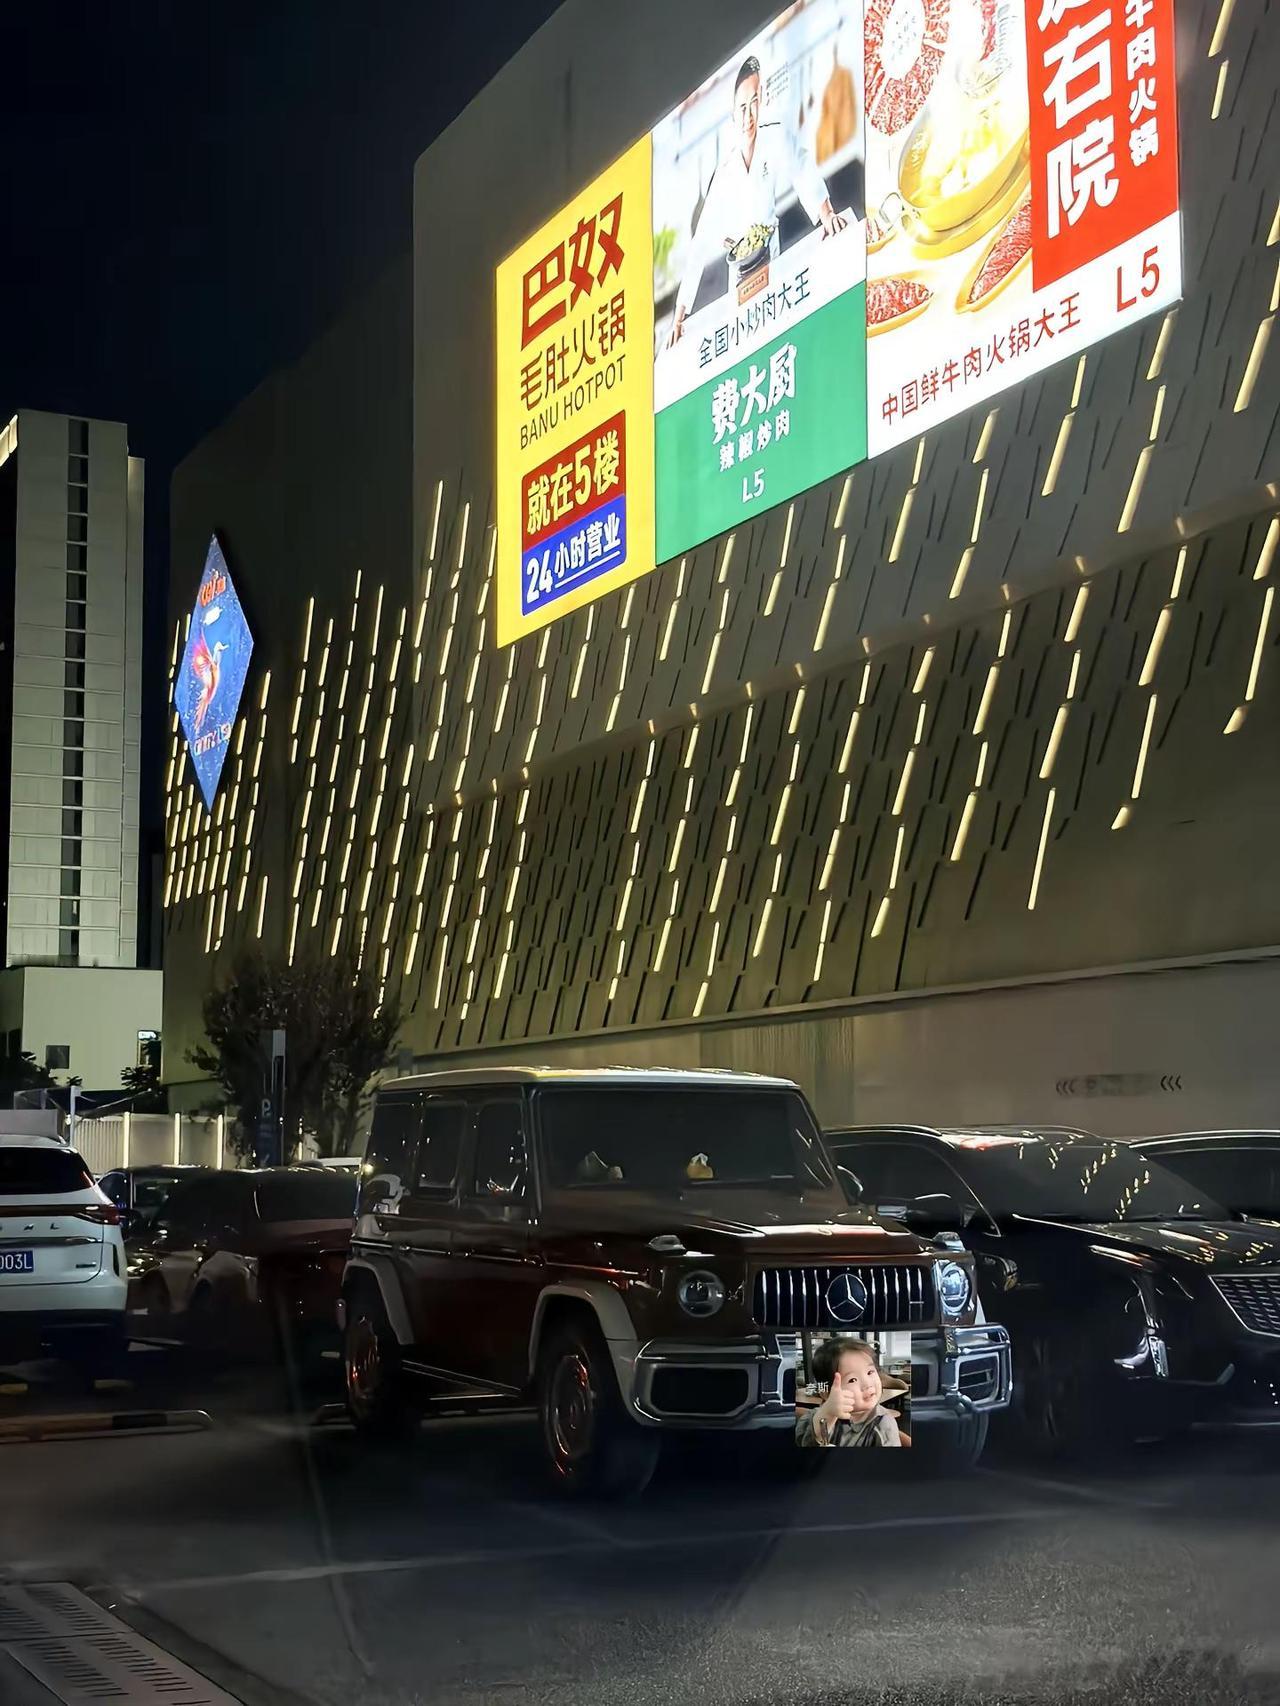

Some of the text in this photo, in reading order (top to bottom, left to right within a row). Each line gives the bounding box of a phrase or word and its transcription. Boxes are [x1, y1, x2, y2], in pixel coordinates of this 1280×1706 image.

[521, 192, 625, 352] 巴奴
[699, 268, 810, 369] 全国小炒肉大王
[1117, 246, 1160, 312] L5
[521, 290, 625, 411] 毛肚火锅
[712, 342, 797, 445] 费大厨
[882, 292, 1081, 425] 中国鲜牛肉火锅大王
[520, 354, 626, 450] BANU HOTPOT
[527, 429, 619, 535] 就在5楼
[742, 468, 765, 503] L5
[526, 512, 621, 604] 24小时营业
